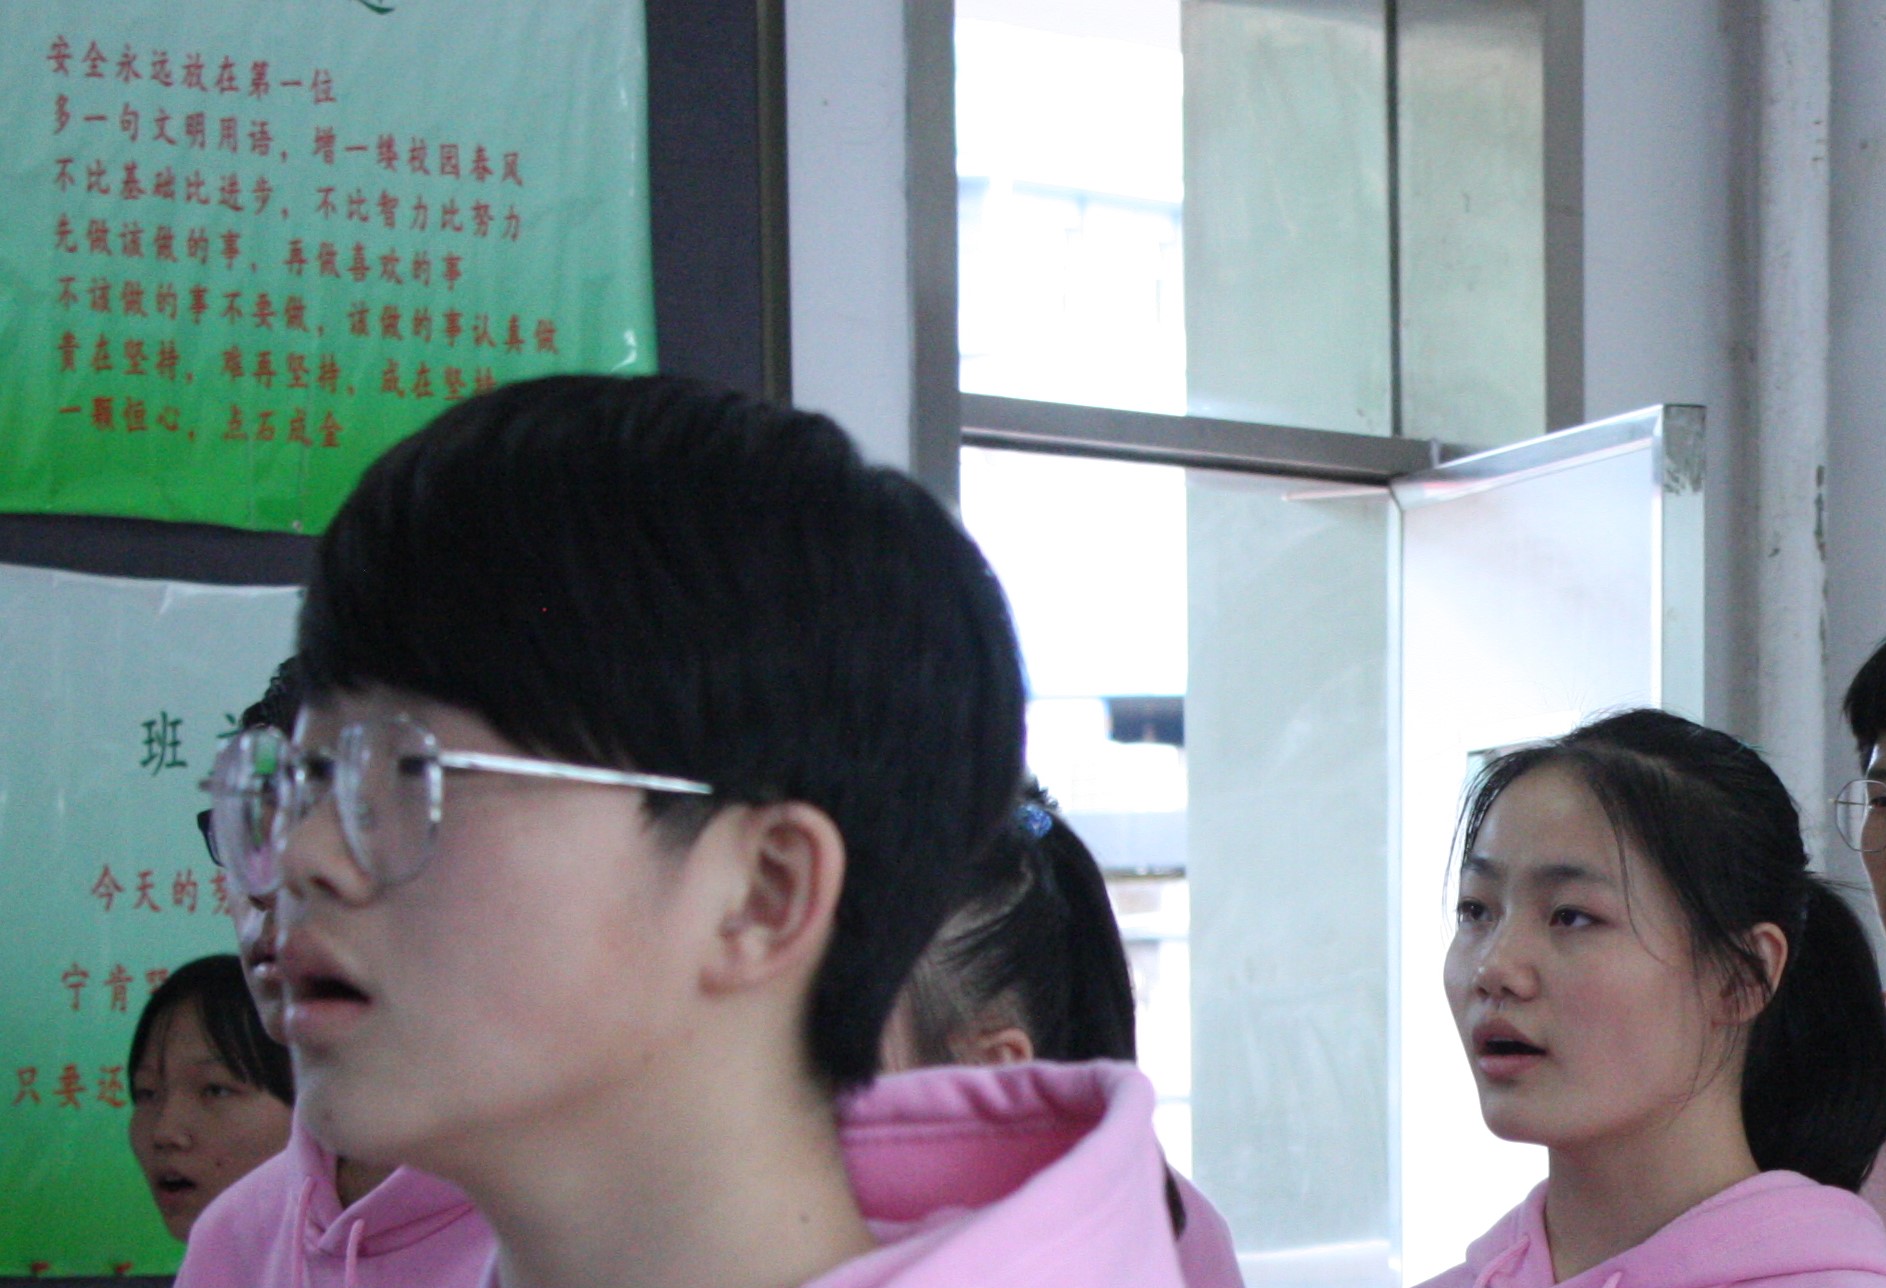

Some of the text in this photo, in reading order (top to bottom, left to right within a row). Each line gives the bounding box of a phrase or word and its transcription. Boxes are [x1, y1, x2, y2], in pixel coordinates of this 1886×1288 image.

[46, 35, 336, 104] 安全永远放在第一位
